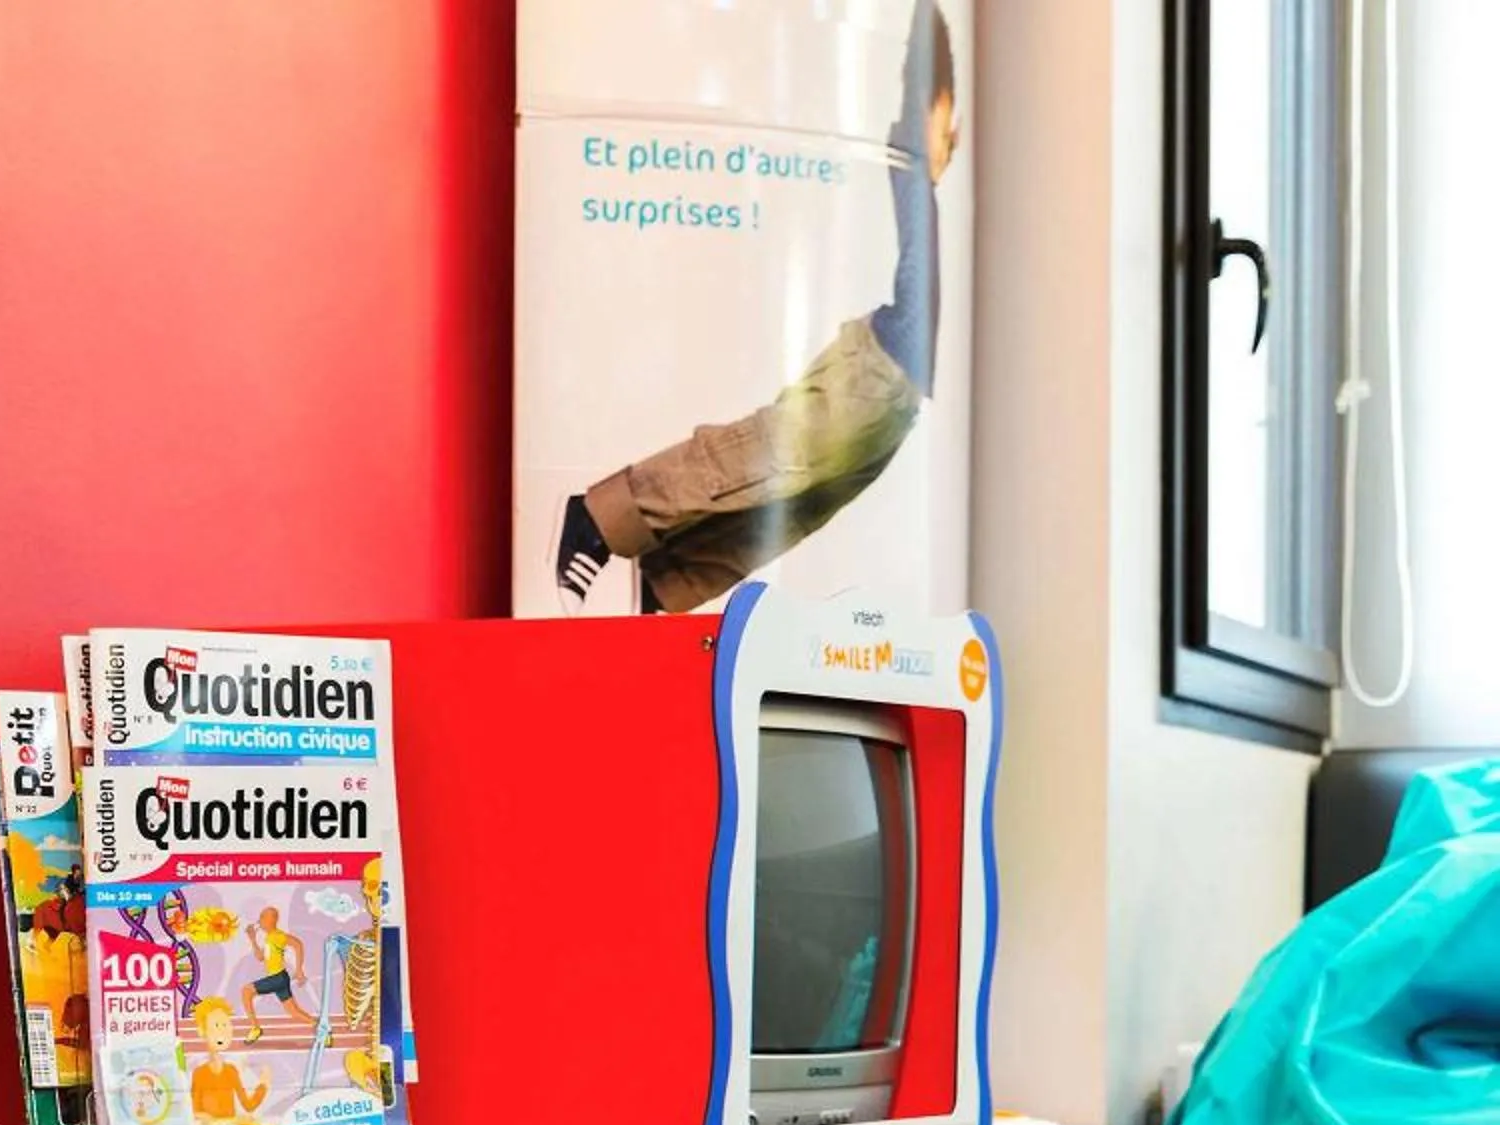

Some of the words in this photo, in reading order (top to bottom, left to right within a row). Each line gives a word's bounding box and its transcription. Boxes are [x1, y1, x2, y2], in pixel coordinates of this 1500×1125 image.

[584, 138, 617, 166] Et
[628, 139, 714, 172] plein
[726, 144, 848, 182] d'autres
[583, 197, 741, 230] surprises
[105, 644, 131, 744] Quotidien
[143, 657, 374, 724] Quotidien
[185, 724, 292, 748] Instruction
[298, 728, 370, 754] civique
[343, 777, 352, 790] 6
[356, 777, 368, 791] €
[96, 779, 119, 873] Quotidien
[136, 787, 367, 850] Quotidien
[176, 861, 233, 877] Spécial
[237, 863, 281, 878] corps
[285, 861, 342, 876] humain
[102, 954, 172, 988] 100
[108, 996, 171, 1013] FICHES
[123, 1018, 170, 1034] garder
[315, 1099, 373, 1119] cadeau
